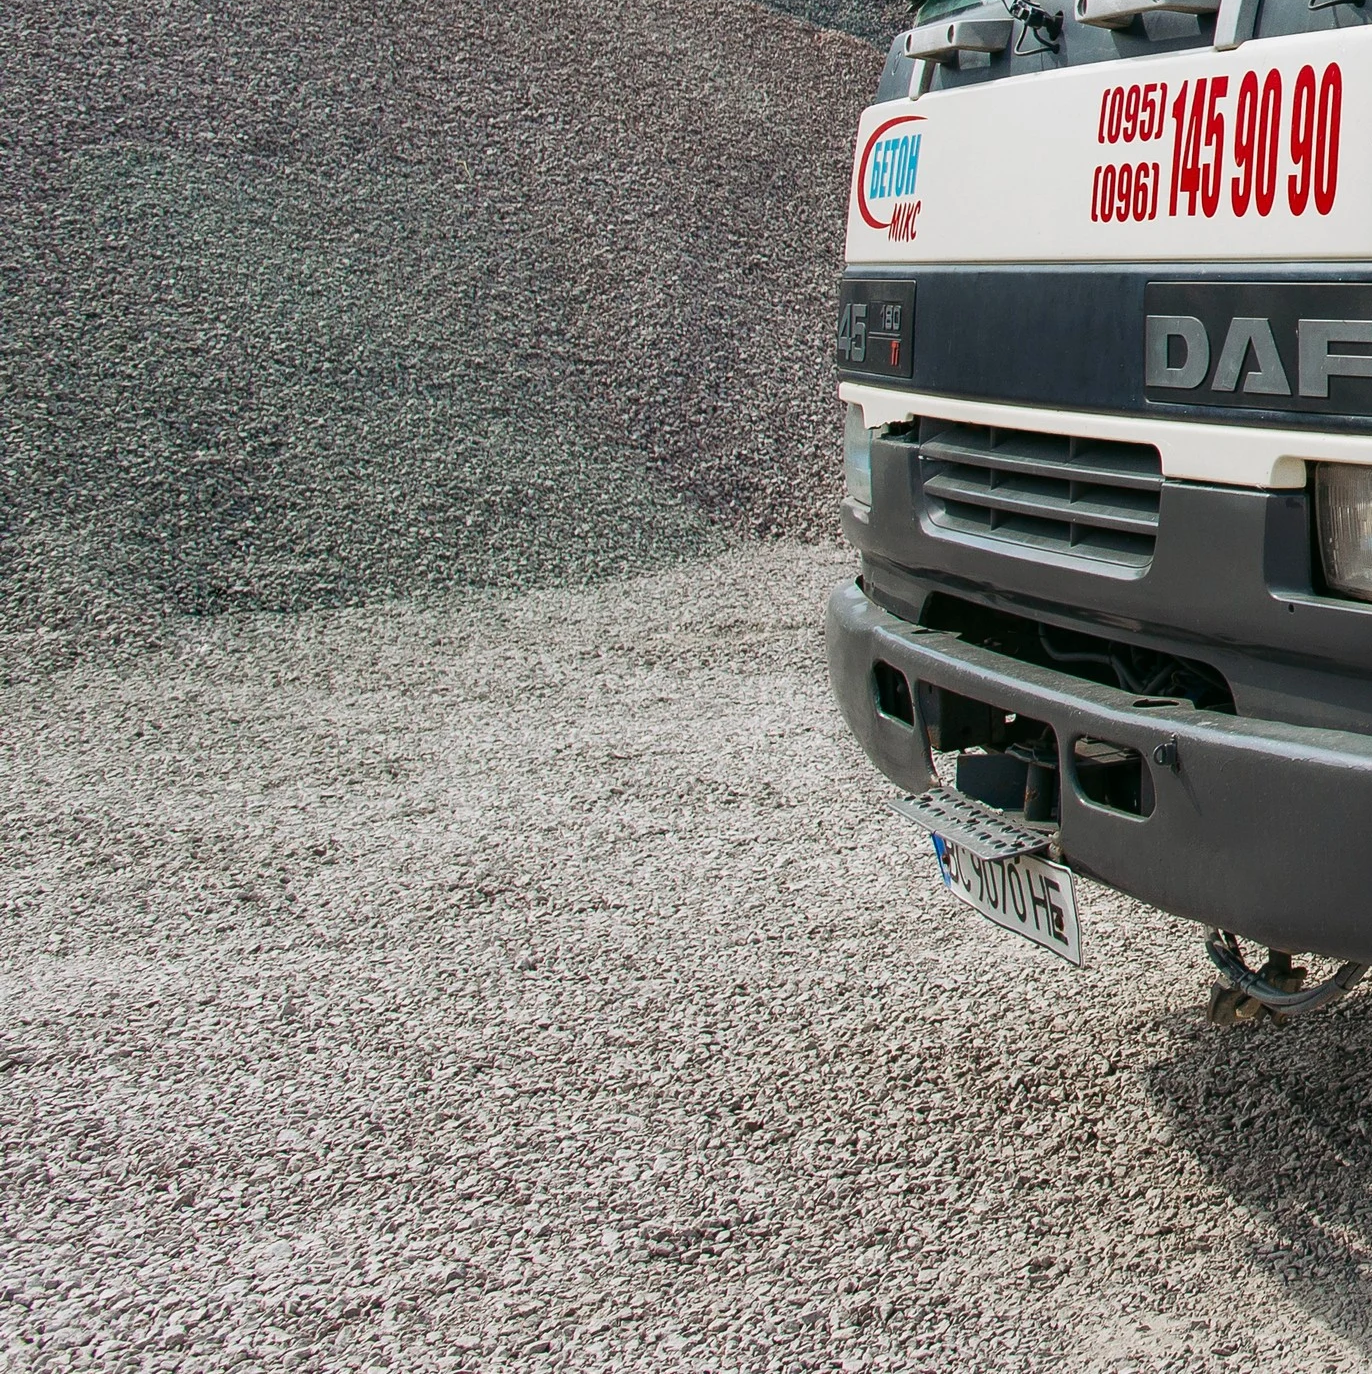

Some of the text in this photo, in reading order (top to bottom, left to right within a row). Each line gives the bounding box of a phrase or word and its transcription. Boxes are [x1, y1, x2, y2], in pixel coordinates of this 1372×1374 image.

[1098, 82, 1168, 144] (095)
[1168, 62, 1342, 218] 145 90 90
[869, 134, 922, 200] БЕТОН
[1091, 162, 1160, 223] (096)
[838, 303, 867, 362] 45
[880, 305, 901, 331] 180
[1026, 868, 1069, 946] HE
